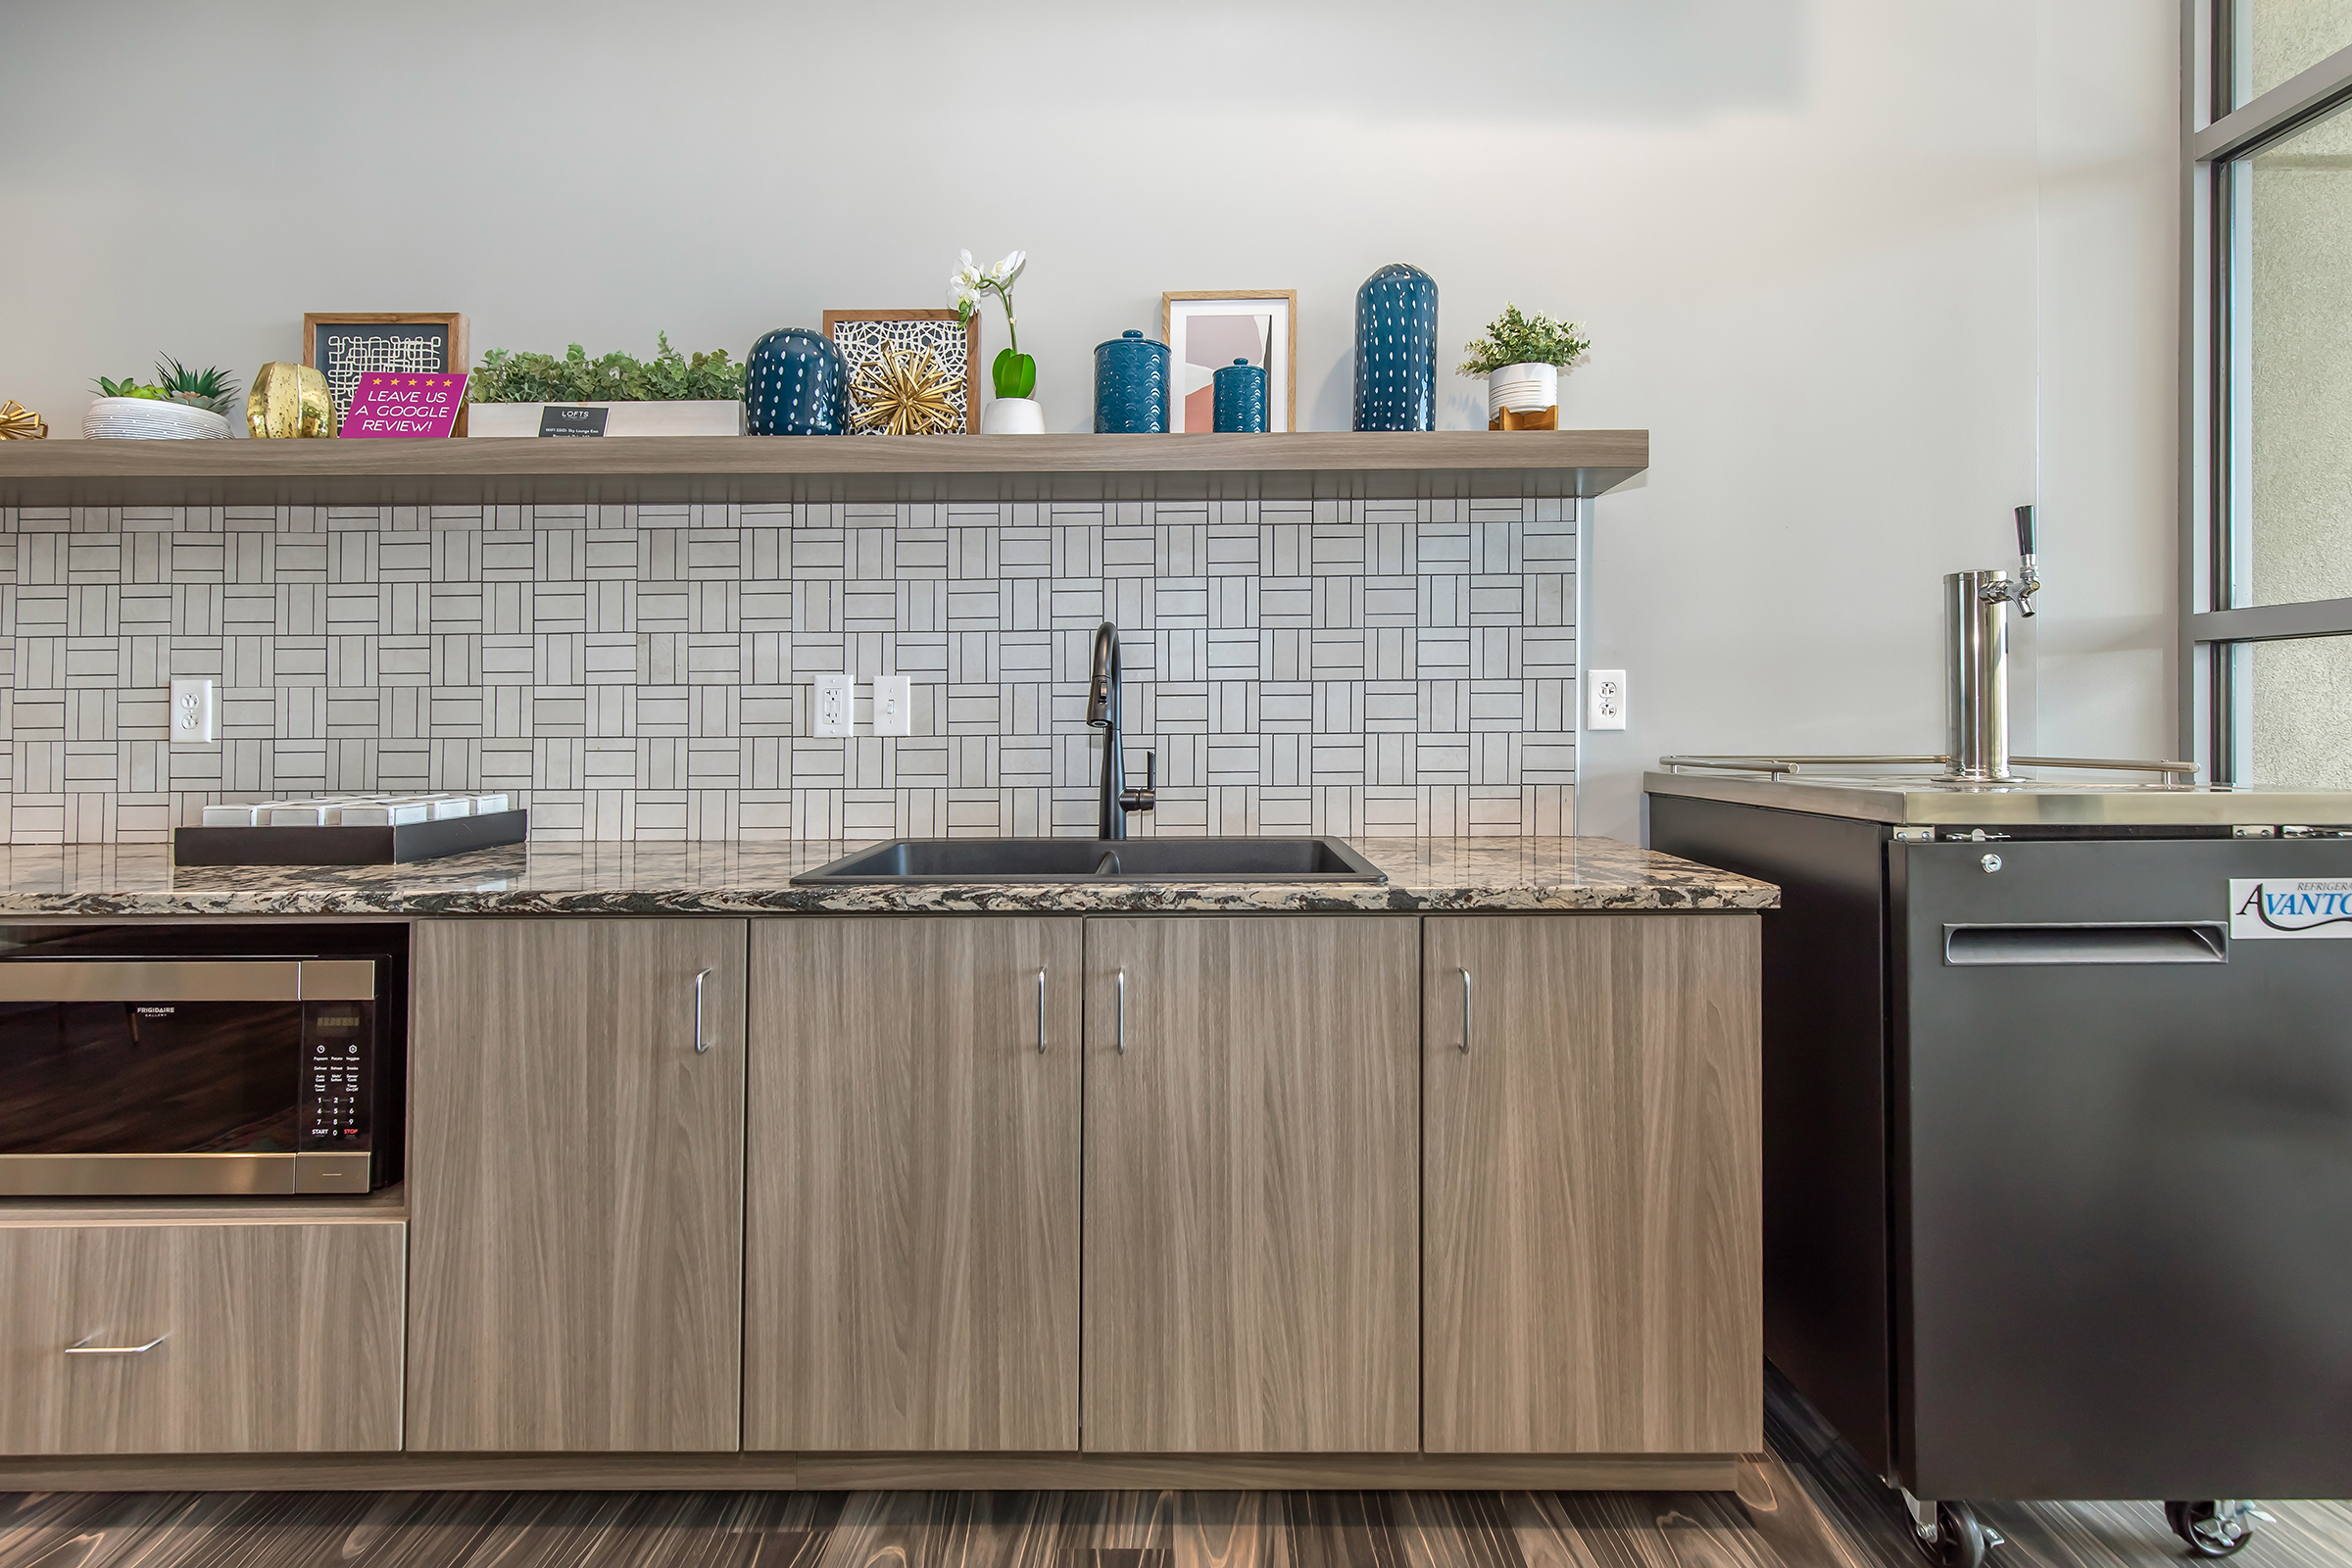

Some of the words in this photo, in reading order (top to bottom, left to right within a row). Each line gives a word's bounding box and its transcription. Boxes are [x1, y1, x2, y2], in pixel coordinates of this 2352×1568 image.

[368, 390, 421, 403] LEAVE
[425, 391, 448, 403] US
[355, 405, 368, 416] A
[376, 405, 450, 417] GOOGLE
[362, 419, 433, 432] REVIEW!
